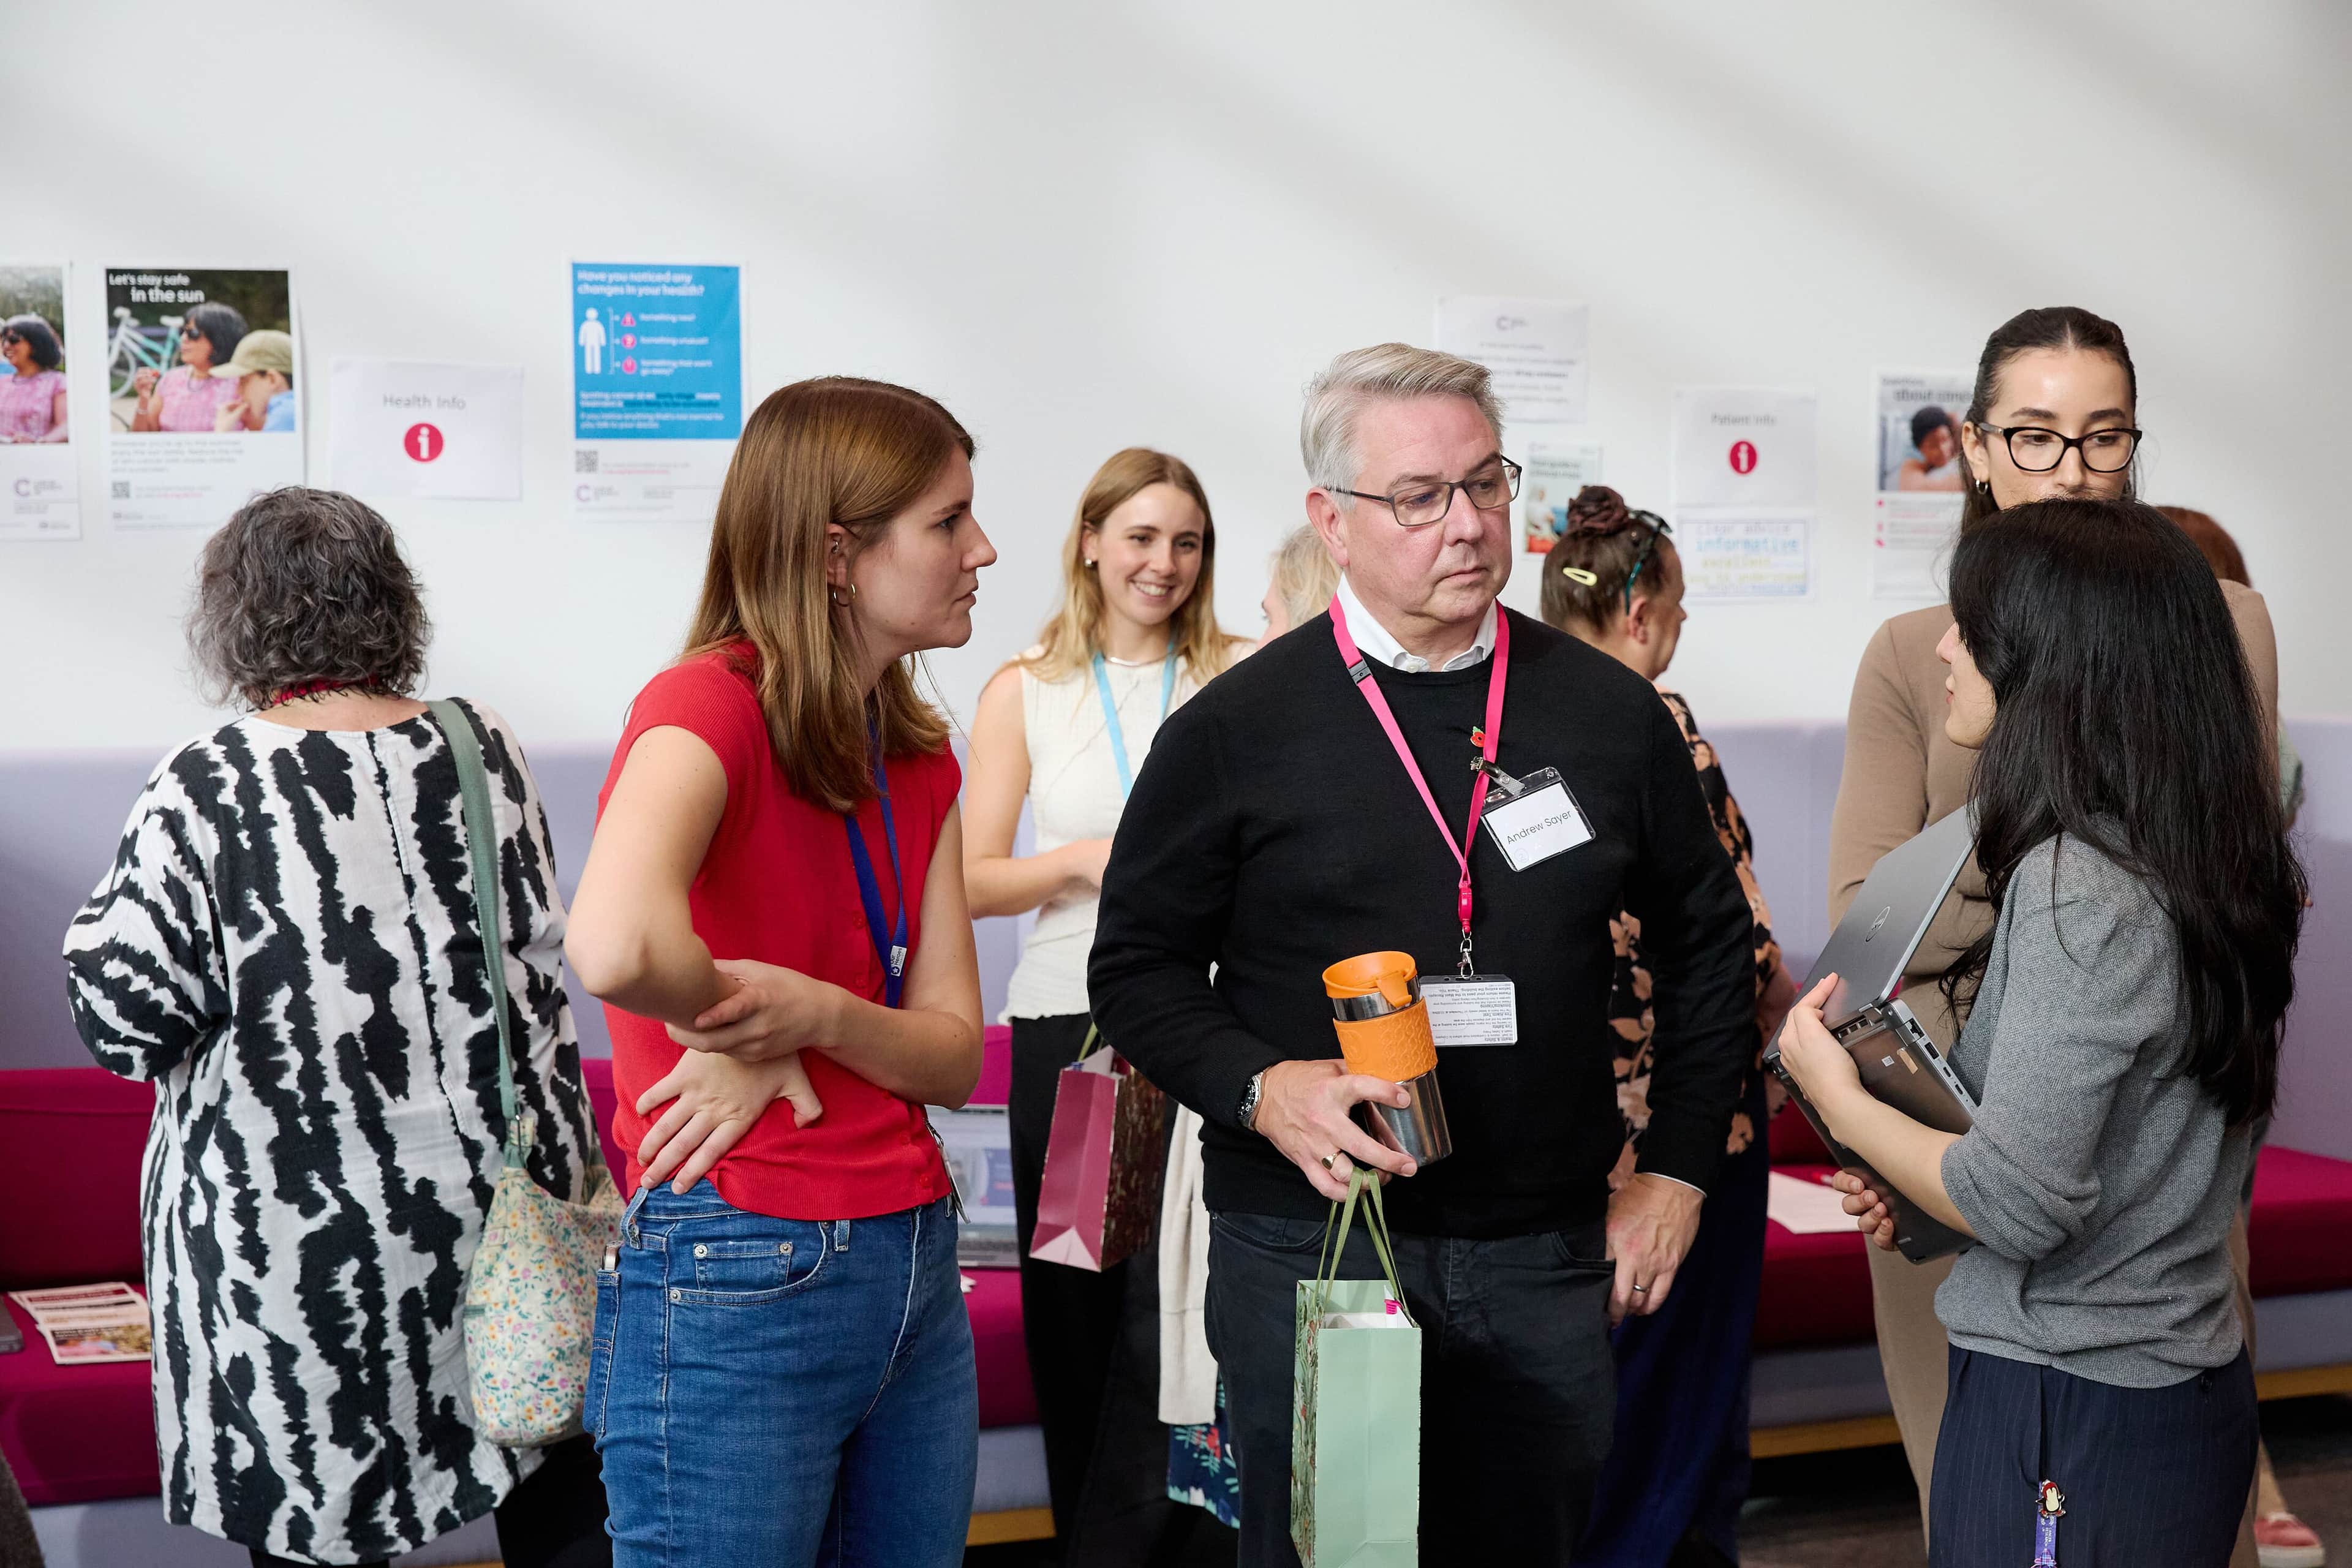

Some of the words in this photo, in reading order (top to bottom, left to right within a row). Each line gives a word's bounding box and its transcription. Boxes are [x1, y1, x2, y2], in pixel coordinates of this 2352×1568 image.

[108, 273, 137, 285] Let's
[137, 274, 162, 287] stay
[164, 273, 190, 285] safe
[578, 271, 606, 281] Have
[608, 273, 628, 283] you
[629, 271, 671, 282] noticed
[672, 273, 692, 284] any
[130, 286, 146, 303] in
[148, 285, 175, 303] the
[177, 290, 205, 303] sun
[578, 283, 624, 296] changes
[626, 284, 635, 295] in
[637, 286, 660, 296] your
[662, 285, 704, 296] health?
[382, 393, 432, 408] Health
[437, 394, 466, 410] Info
[1894, 390, 1931, 402] about
[1711, 412, 1749, 426] Patient
[1752, 413, 1777, 426] Info
[1697, 524, 1735, 536] clear
[1695, 537, 1800, 552] informative
[1506, 823, 1544, 844] Andrew
[1544, 810, 1572, 826] Sayer
